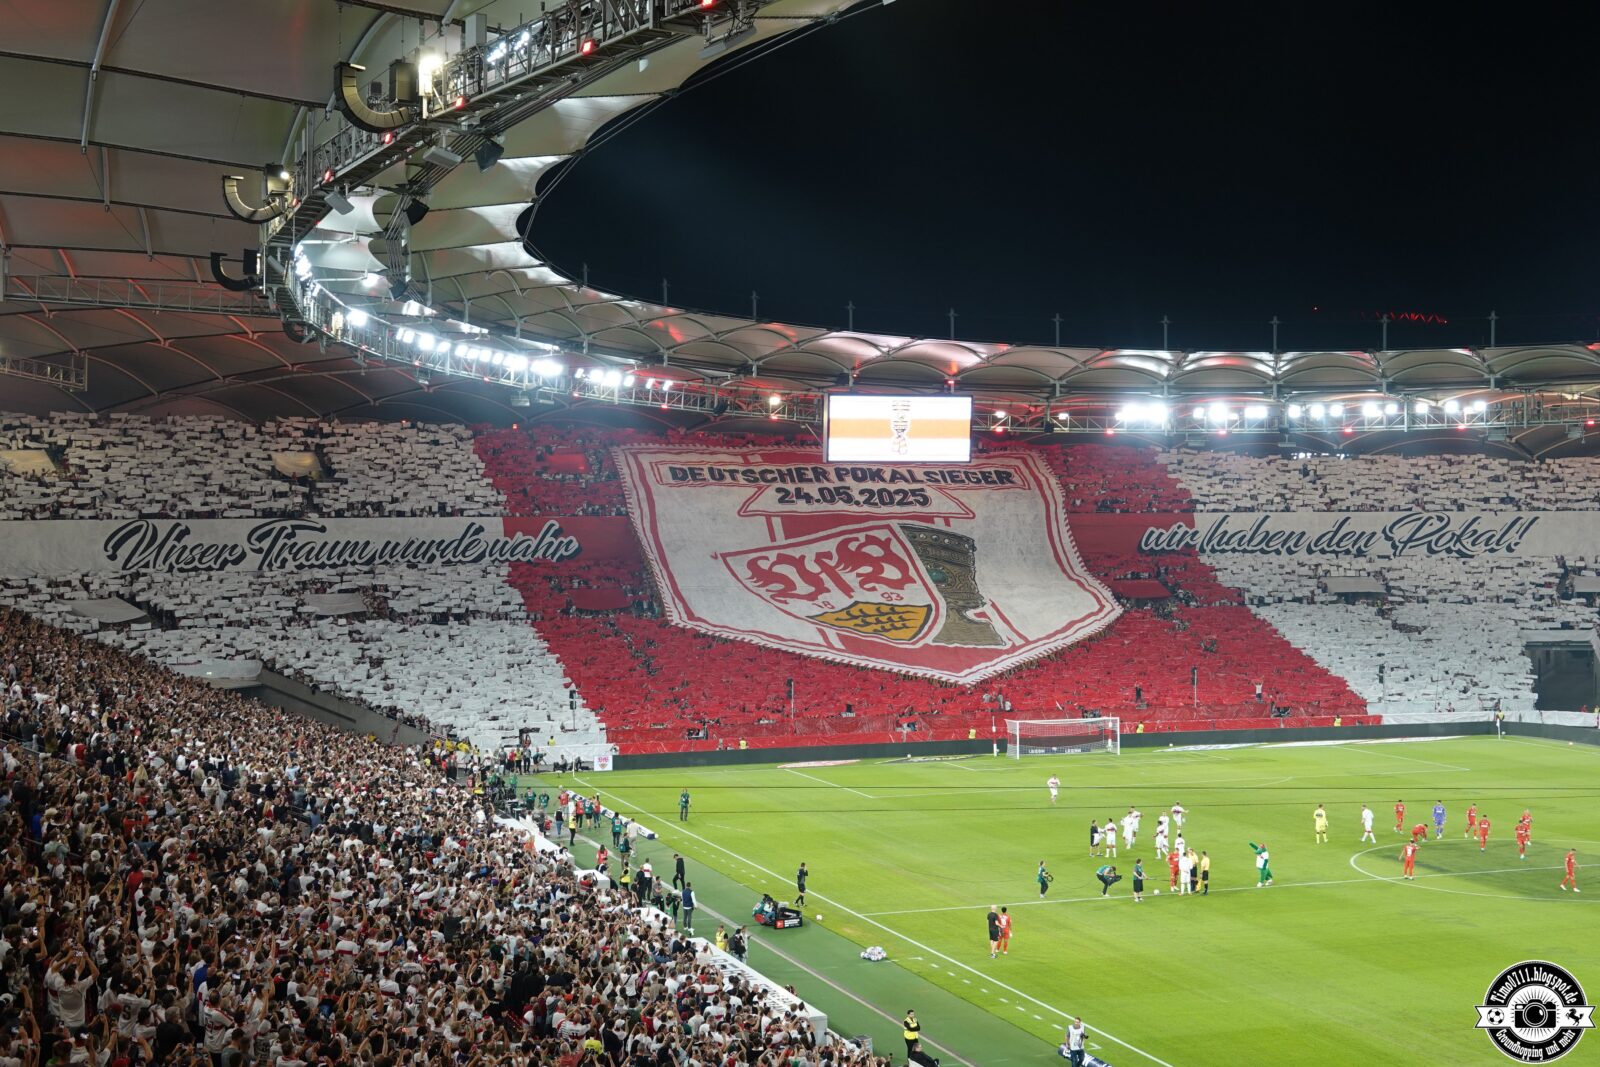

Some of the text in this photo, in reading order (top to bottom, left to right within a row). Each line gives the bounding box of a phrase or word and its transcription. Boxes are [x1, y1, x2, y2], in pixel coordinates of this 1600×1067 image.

[669, 466, 833, 484] DEUTSCHER
[775, 486, 931, 507] 24.05.2025
[1138, 511, 1540, 558] wir haben den Pokal!
[104, 518, 582, 573] Unser Traum wurde wahr
[880, 591, 904, 602] 93
